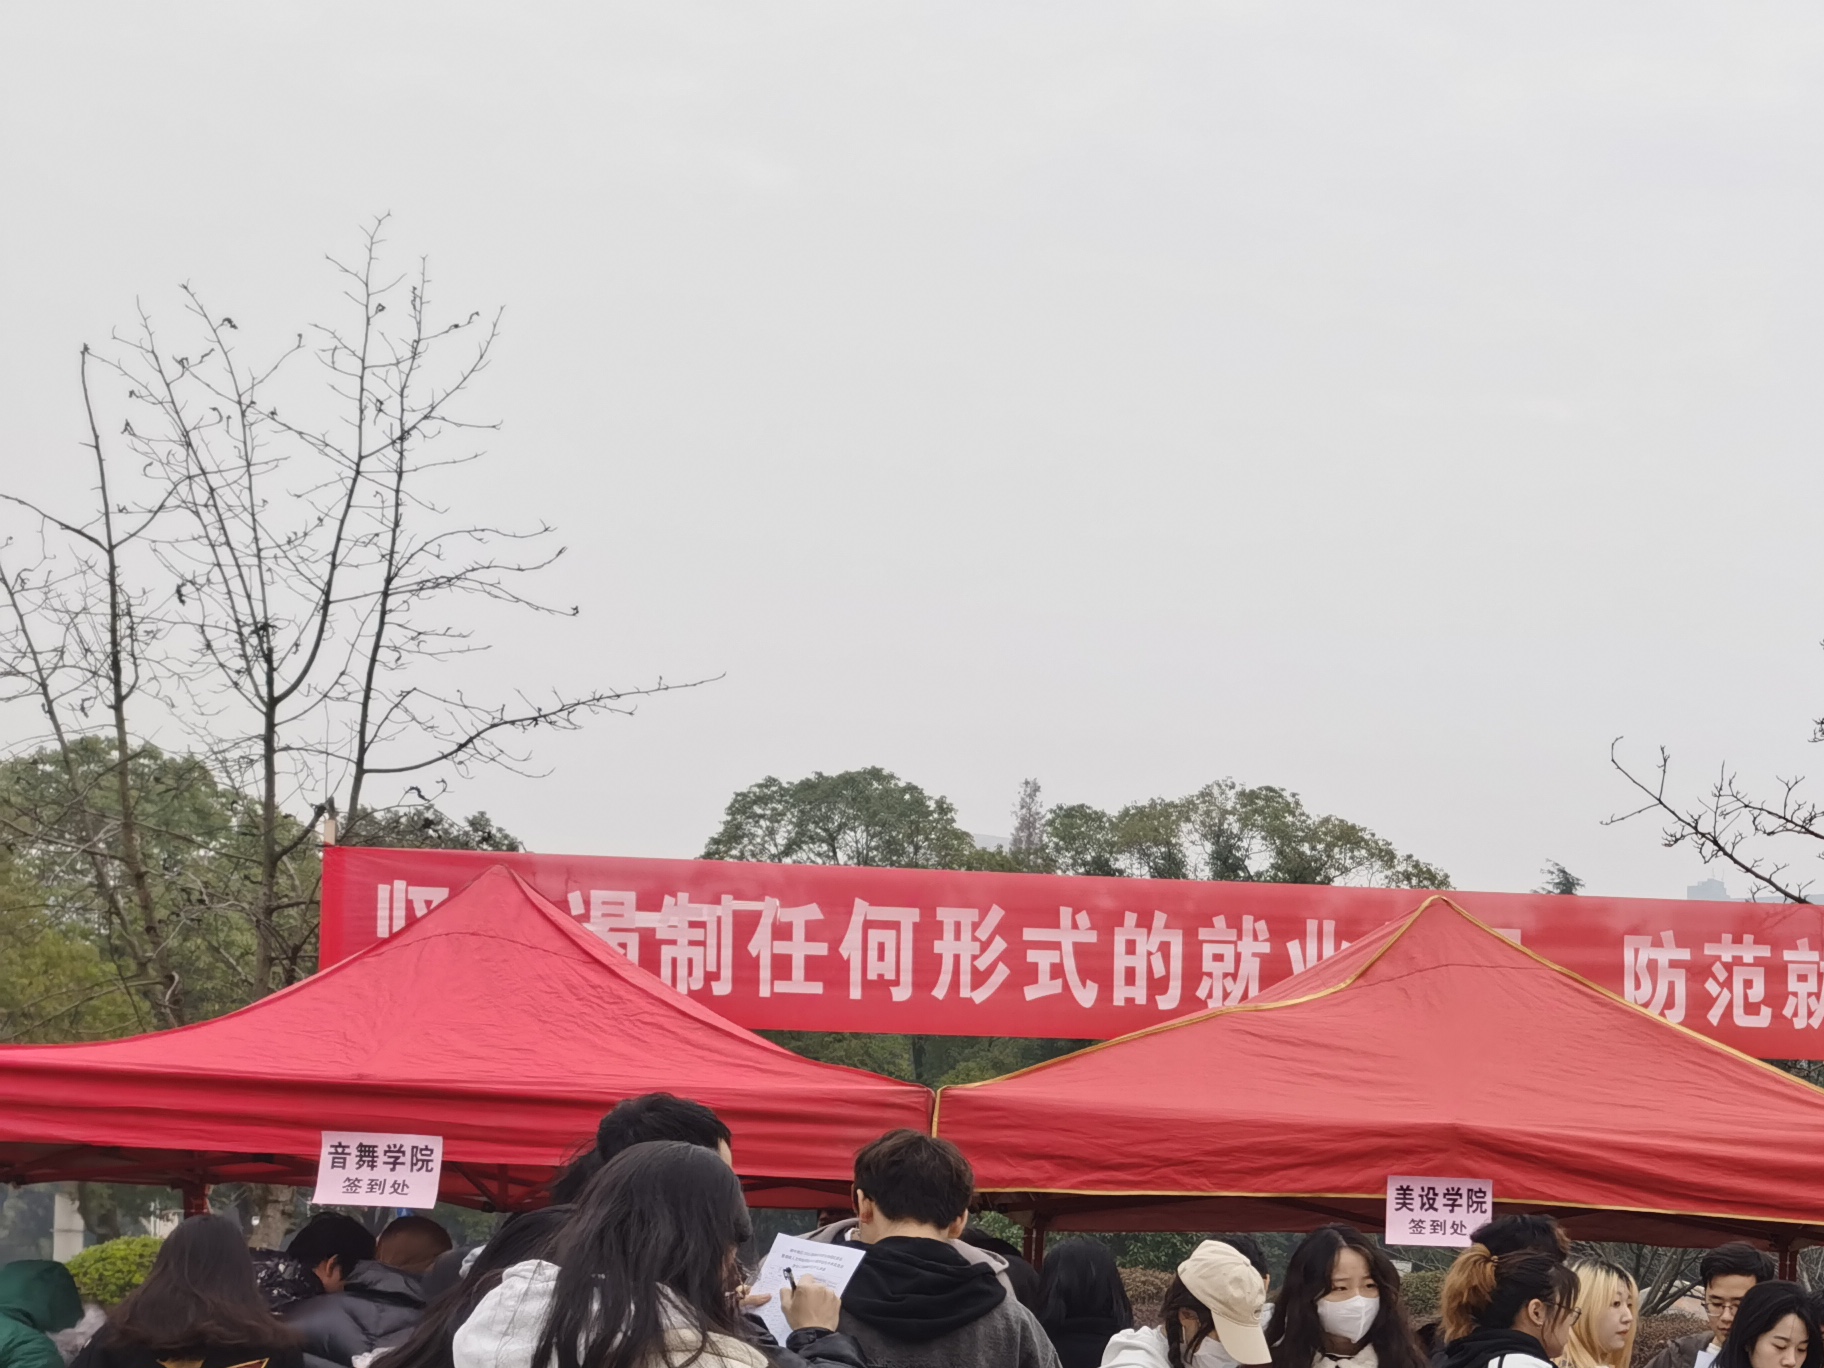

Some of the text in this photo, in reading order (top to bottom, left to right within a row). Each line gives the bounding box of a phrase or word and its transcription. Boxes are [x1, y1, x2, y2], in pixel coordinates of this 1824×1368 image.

[327, 1141, 435, 1173] 音舞学院
[341, 1176, 410, 1196] 签到处
[1394, 1184, 1488, 1214] 美设学院
[1408, 1217, 1469, 1236] 签到处
